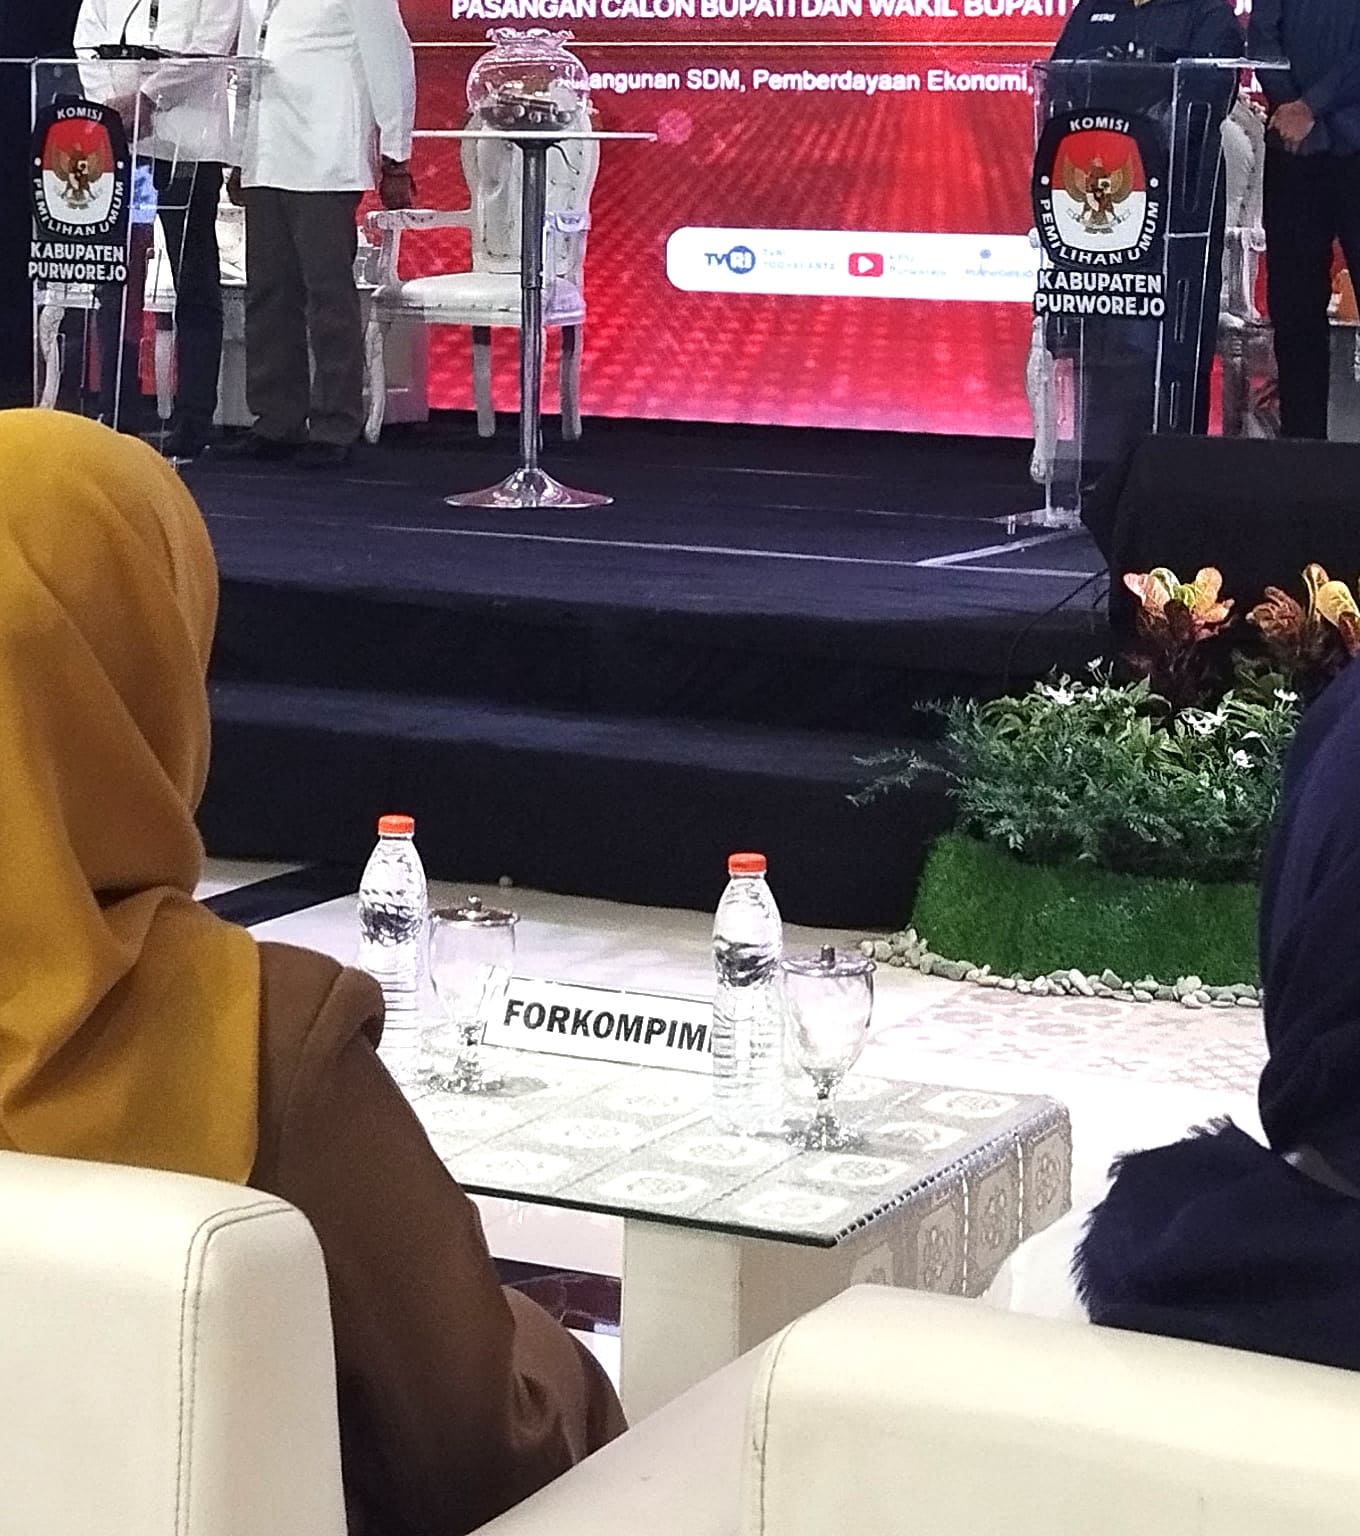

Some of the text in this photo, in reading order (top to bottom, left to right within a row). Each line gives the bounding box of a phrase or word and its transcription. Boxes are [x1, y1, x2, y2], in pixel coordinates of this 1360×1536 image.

[590, 68, 1034, 96] angunan SDM, Pemberdayaan Ekonomi,
[57, 107, 103, 122] KOMISI
[1069, 116, 1130, 133] KOMISI
[33, 177, 124, 236] PEMILIHAN UMUM
[1040, 199, 1160, 265] PEMILIHAN UMUM
[31, 241, 124, 262] KABUPATEN
[28, 262, 127, 281] PURWOREJO
[1039, 271, 1162, 294] KABUPATEN
[1035, 293, 1166, 316] PURWOREJO
[503, 998, 715, 1056] FORKOMPIM
